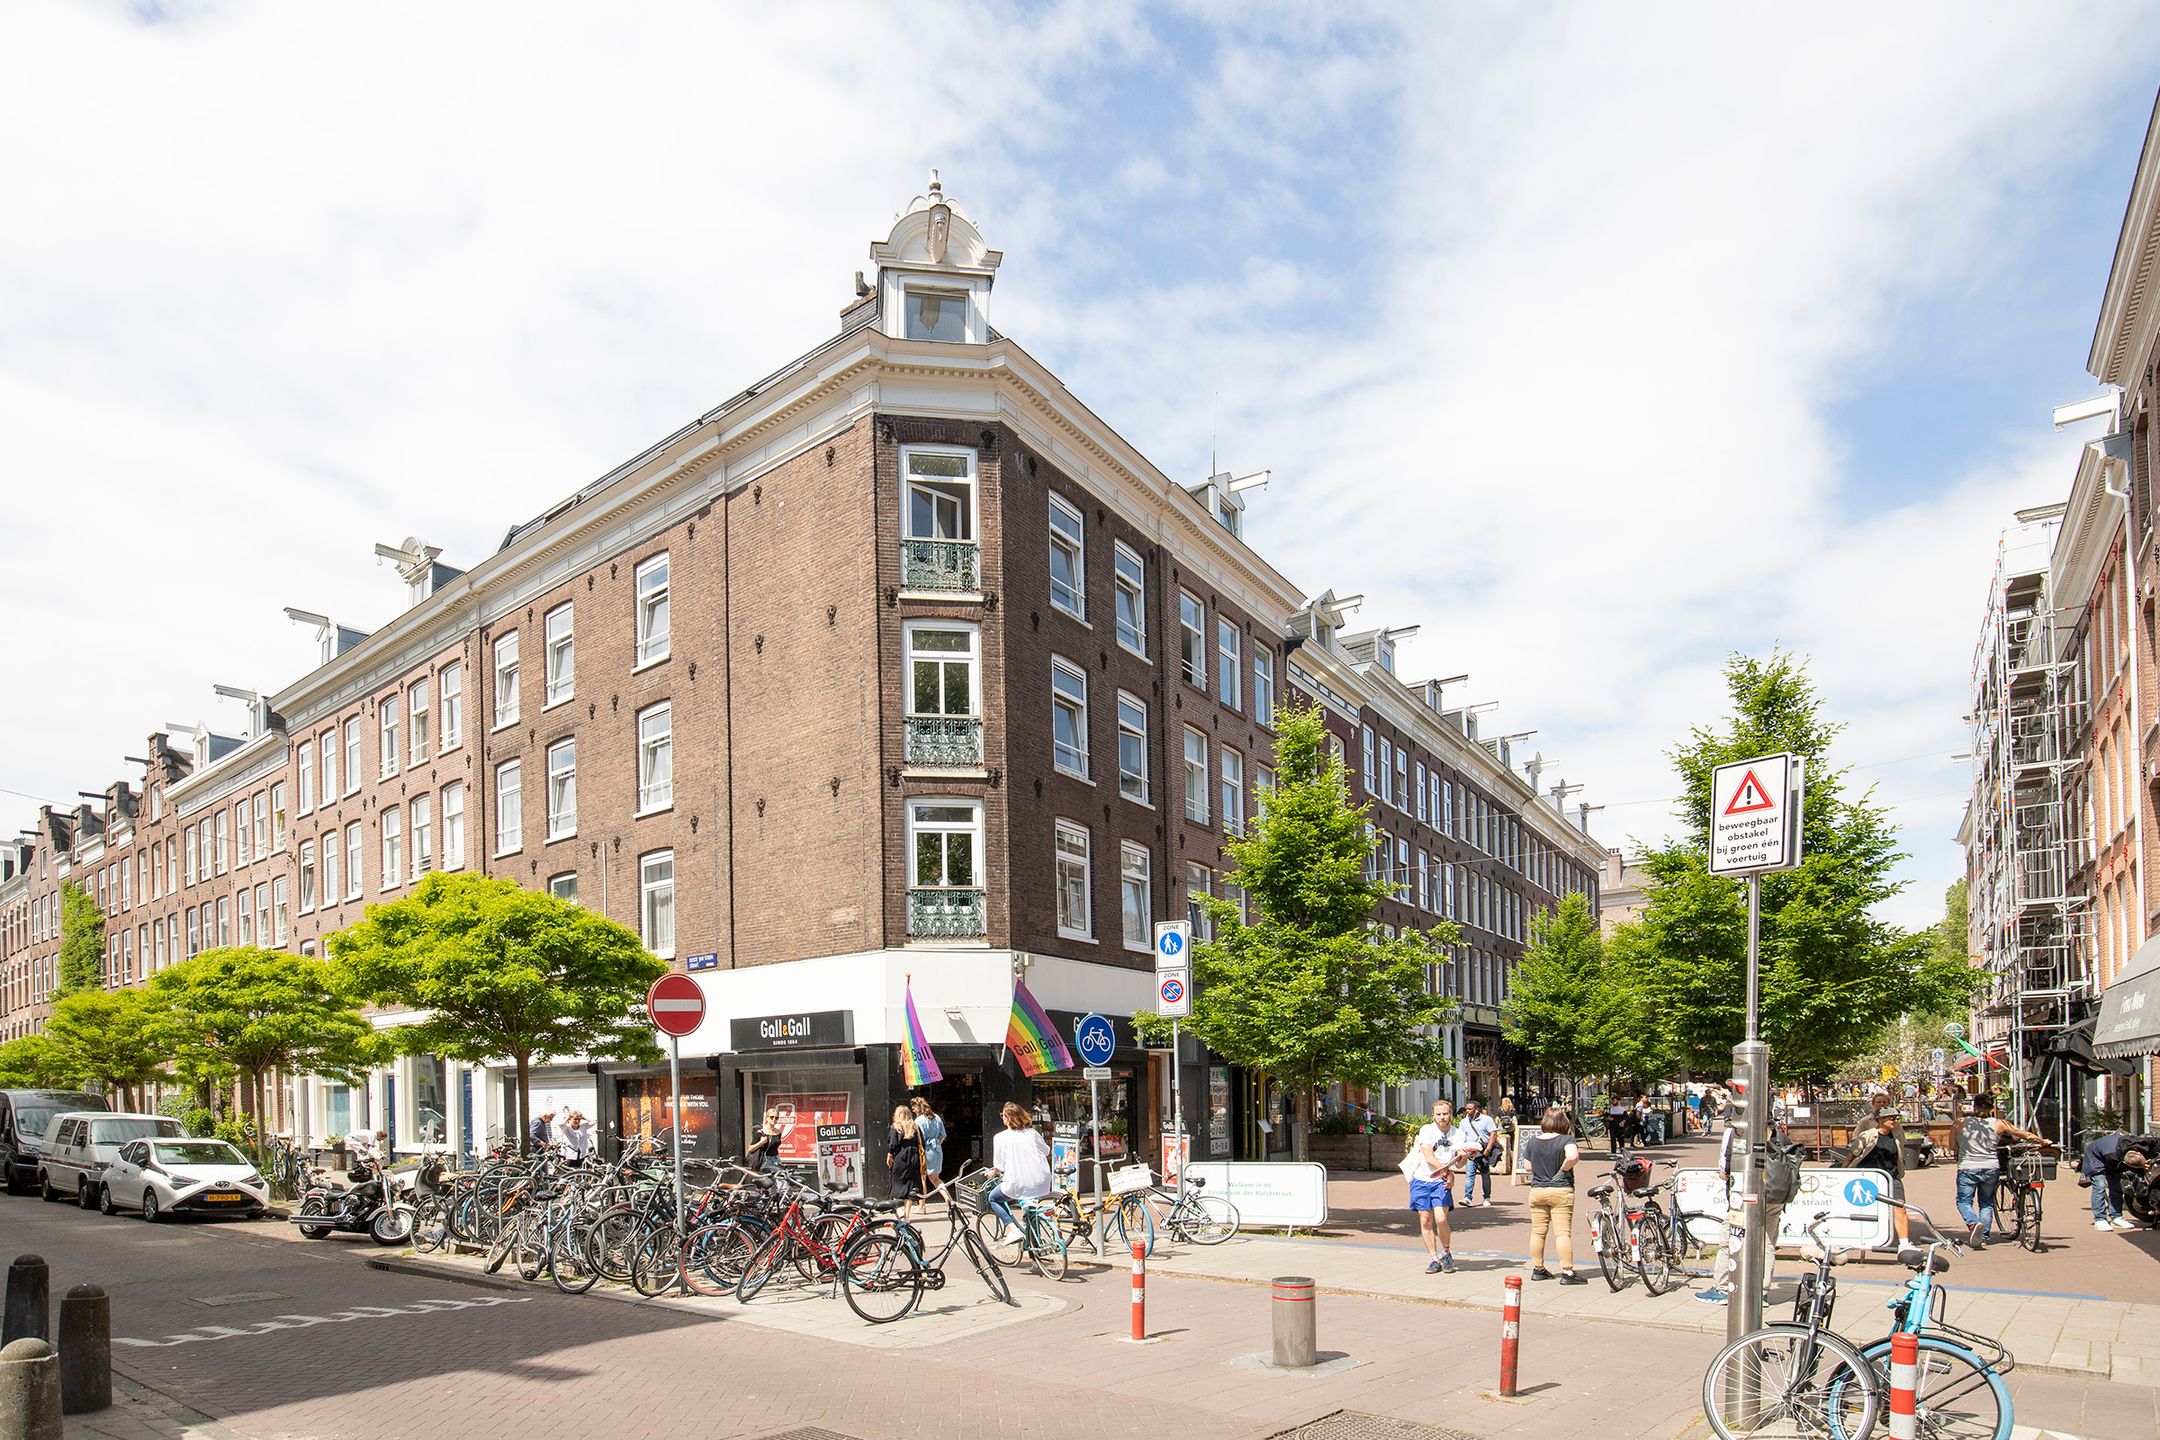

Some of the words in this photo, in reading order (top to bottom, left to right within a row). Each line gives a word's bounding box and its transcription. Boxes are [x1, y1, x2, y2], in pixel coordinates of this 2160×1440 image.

[1719, 816, 1778, 831] beweegbaar
[1727, 828, 1768, 841] obstakel
[1716, 846, 1728, 855] bij
[1730, 843, 1758, 854] groen
[1761, 839, 1779, 847] één
[1727, 852, 1767, 863] voertuig
[760, 1017, 810, 1038] Gall&Gall
[1802, 1198, 1833, 1206] straat!
